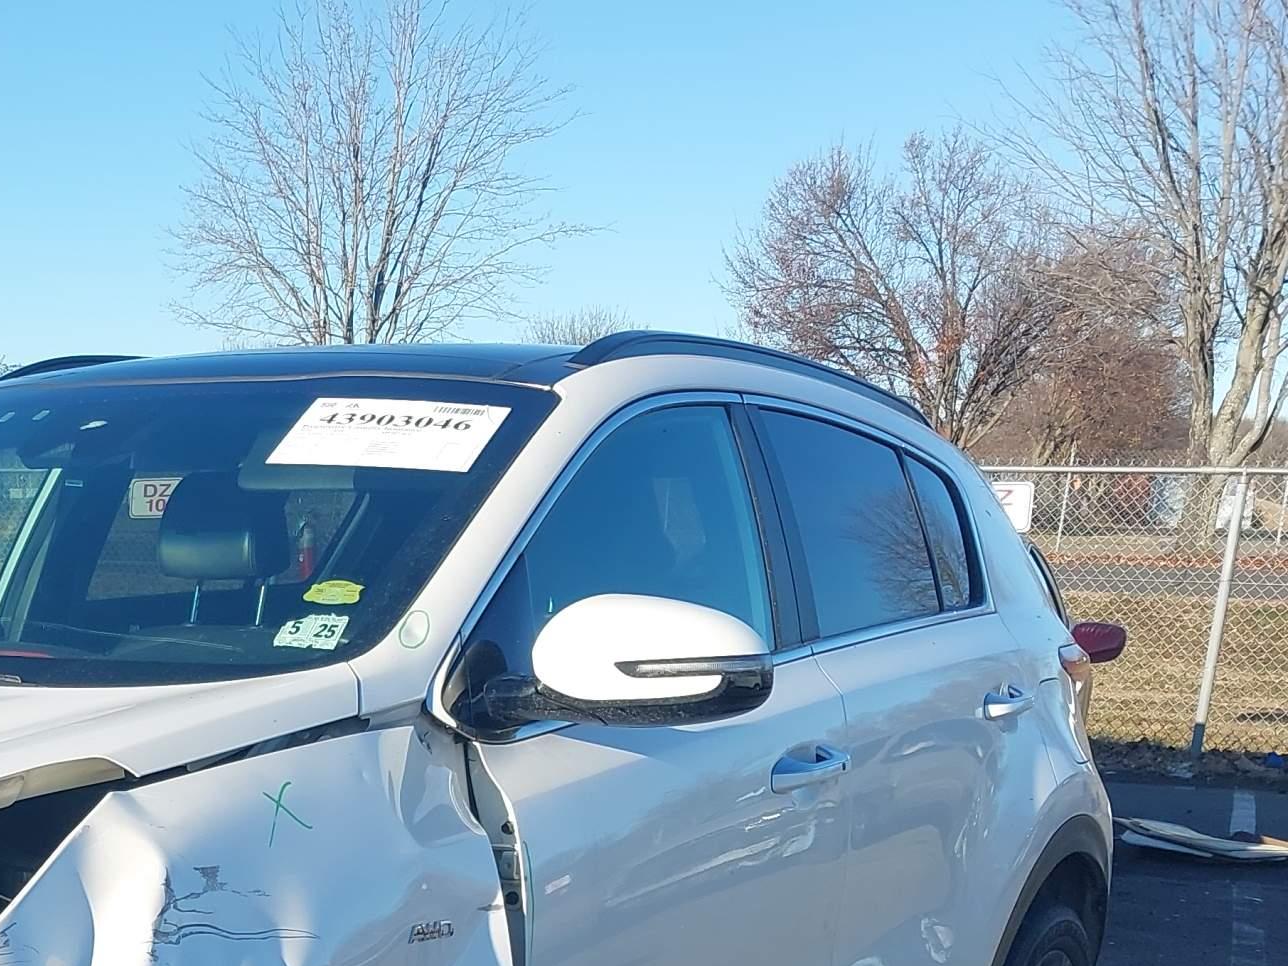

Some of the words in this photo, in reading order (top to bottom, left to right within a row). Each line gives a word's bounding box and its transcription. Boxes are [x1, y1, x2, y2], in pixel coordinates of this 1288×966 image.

[319, 412, 473, 431] 43903046
[143, 483, 172, 498] DZ
[146, 498, 167, 512] 10
[288, 620, 304, 635] 5
[313, 623, 339, 639] 25
[407, 919, 455, 944] AWD
